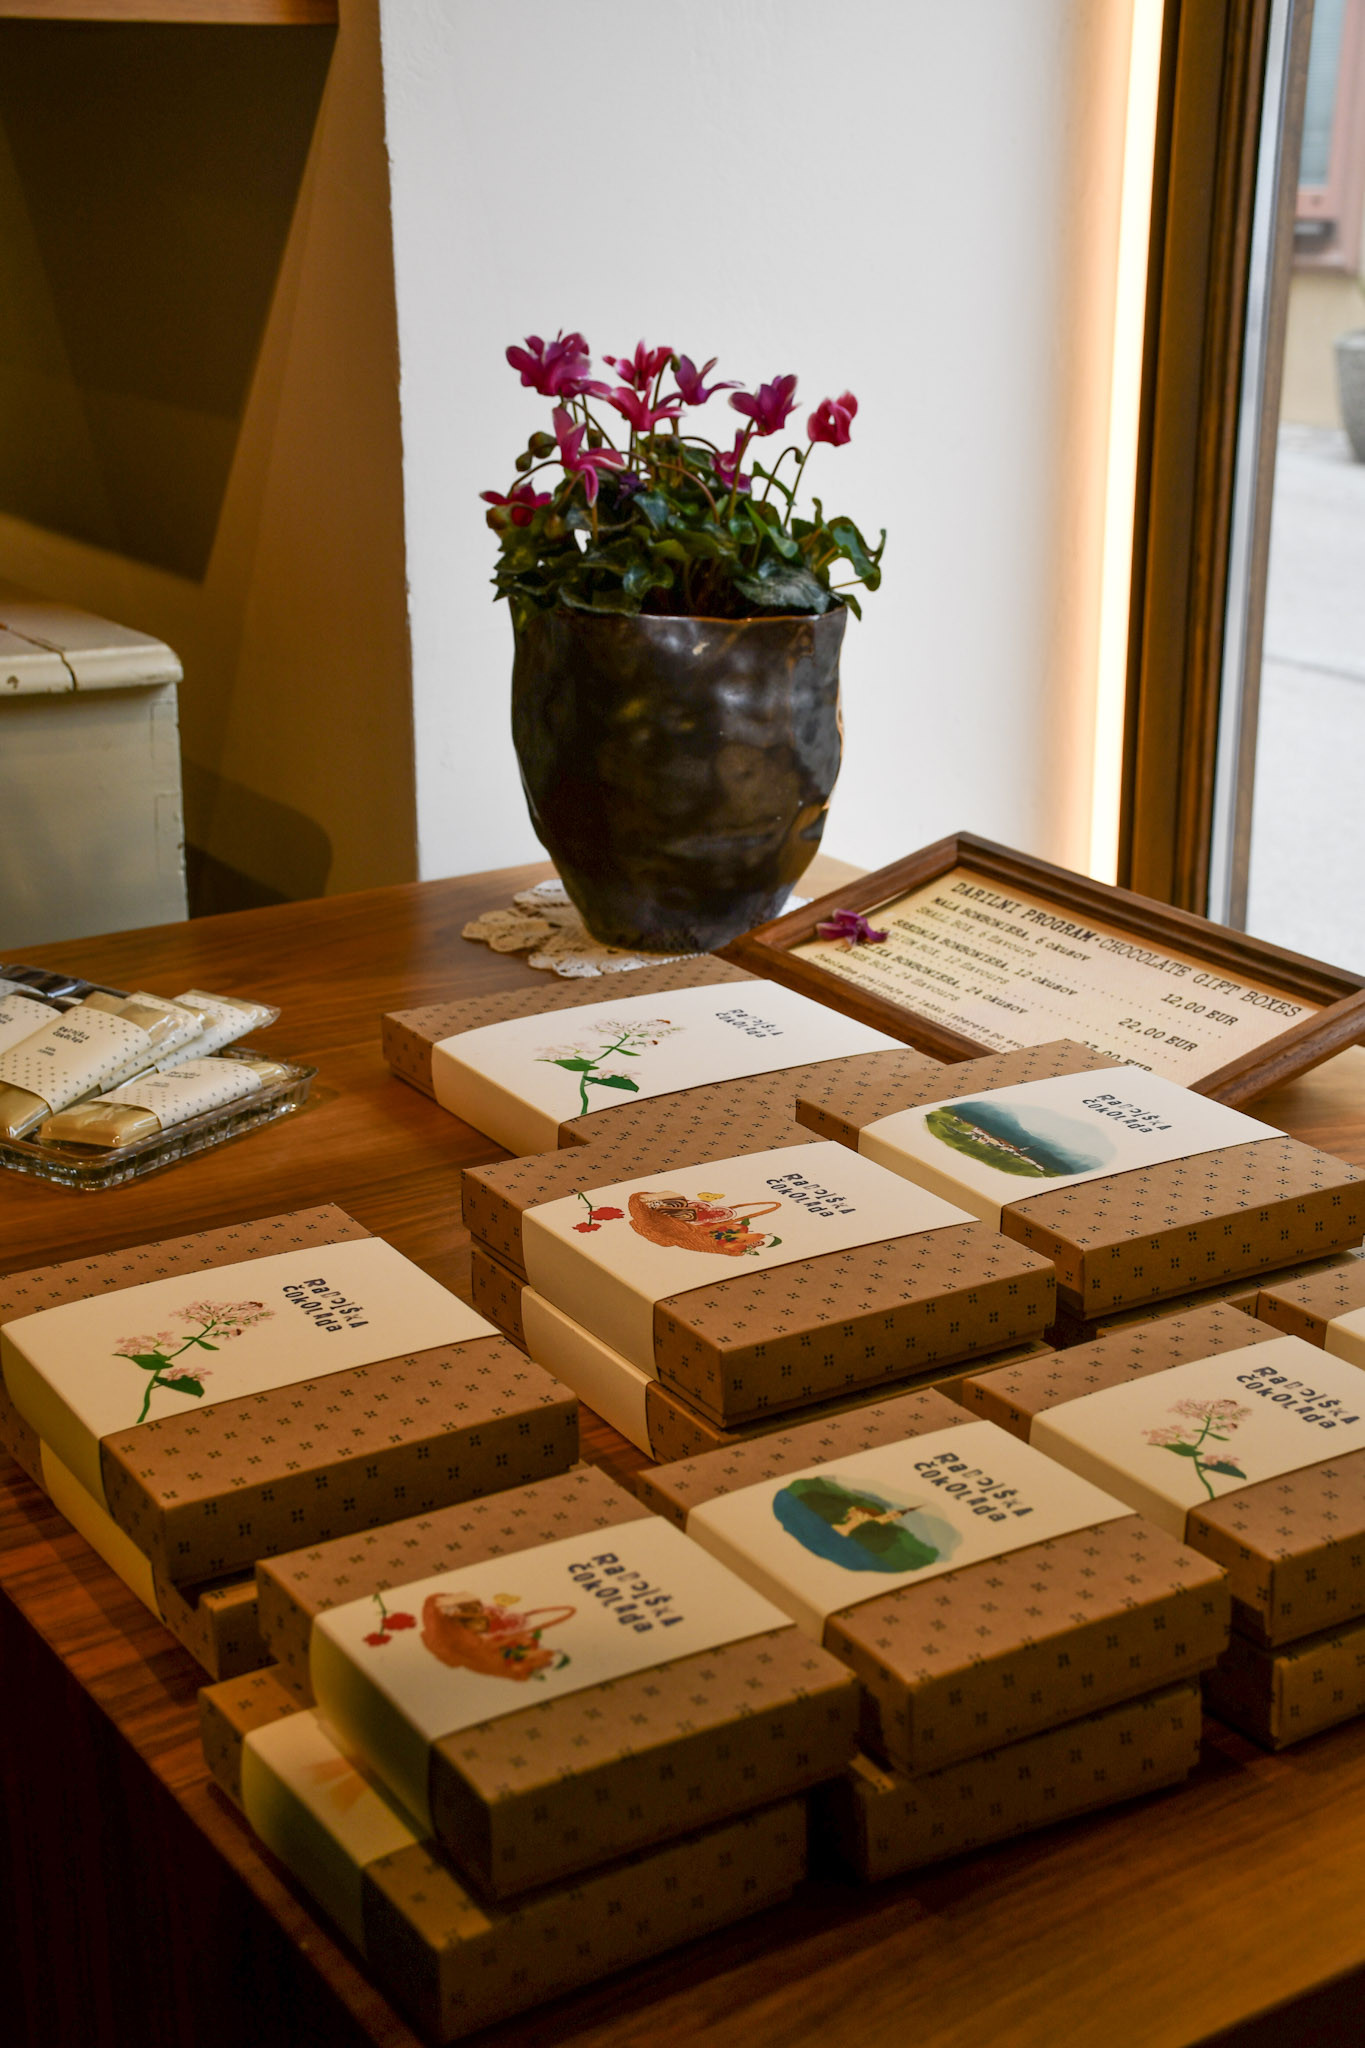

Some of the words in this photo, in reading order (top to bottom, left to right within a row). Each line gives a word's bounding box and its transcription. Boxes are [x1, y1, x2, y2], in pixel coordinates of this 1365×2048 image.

[951, 882, 1022, 914] DARILNI
[1021, 909, 1096, 943] PROGRAM
[1099, 938, 1192, 977] CHOCOLATE
[1193, 973, 1241, 995] GIFT
[1240, 990, 1302, 1018] BOXES
[1035, 937, 1046, 945] 6
[1045, 941, 1091, 962] okusov
[1014, 968, 1032, 978] 12
[1032, 975, 1079, 996] okusov
[965, 985, 982, 996] 24
[982, 993, 1029, 1015] okusov
[1160, 993, 1206, 1013] 12,00
[1205, 1010, 1239, 1026] EUR
[1118, 1017, 1165, 1039] 22,00
[1164, 1035, 1198, 1053] EUR
